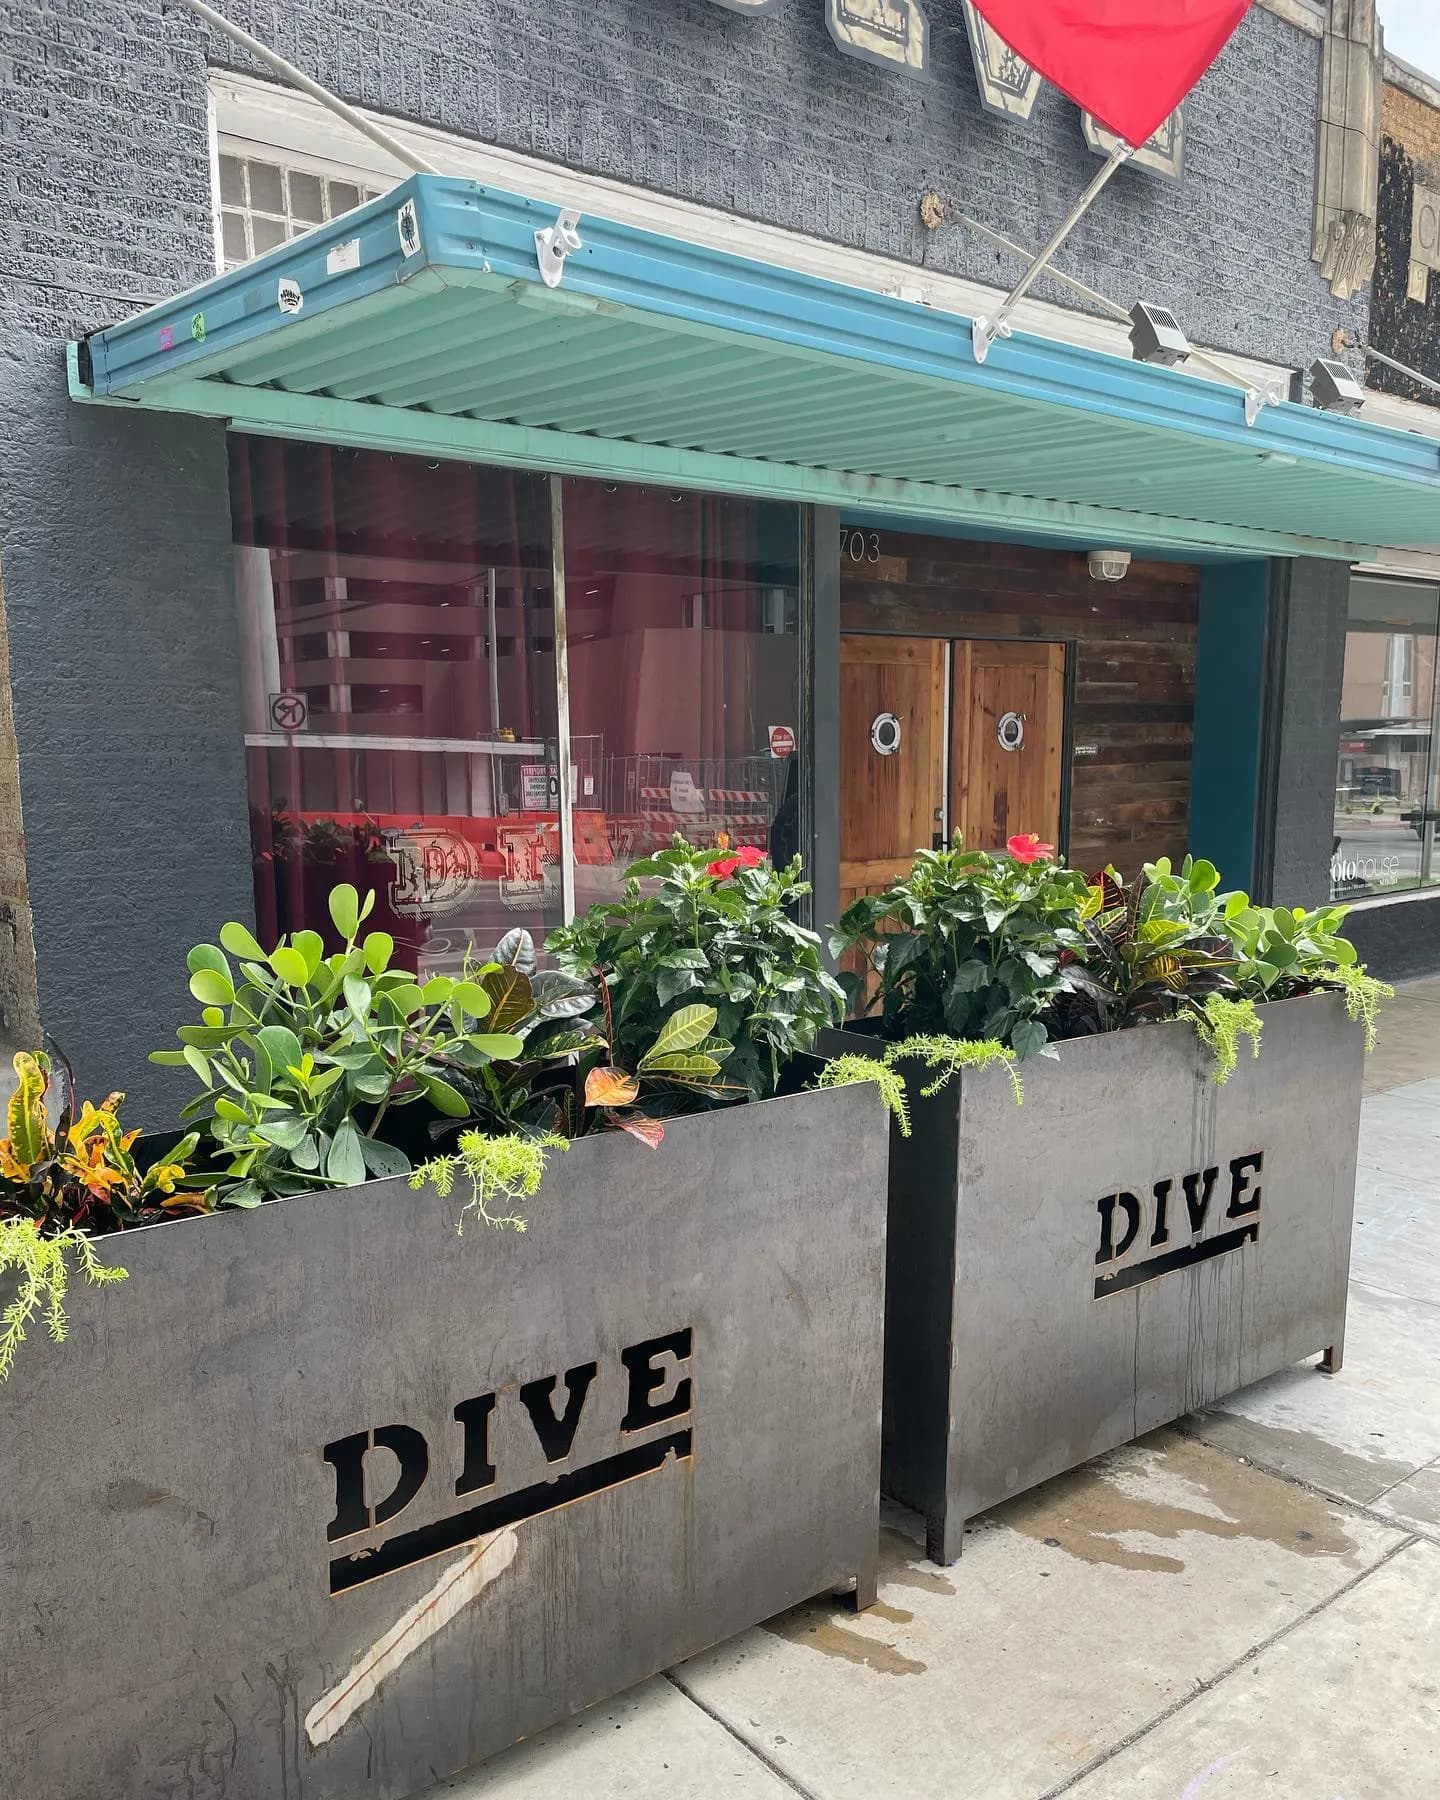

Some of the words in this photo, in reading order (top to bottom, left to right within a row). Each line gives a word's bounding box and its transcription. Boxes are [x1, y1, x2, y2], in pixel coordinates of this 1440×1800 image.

[839, 530, 880, 564] 703
[1095, 1151, 1264, 1265] DIVE
[324, 1327, 693, 1544] DIVE
